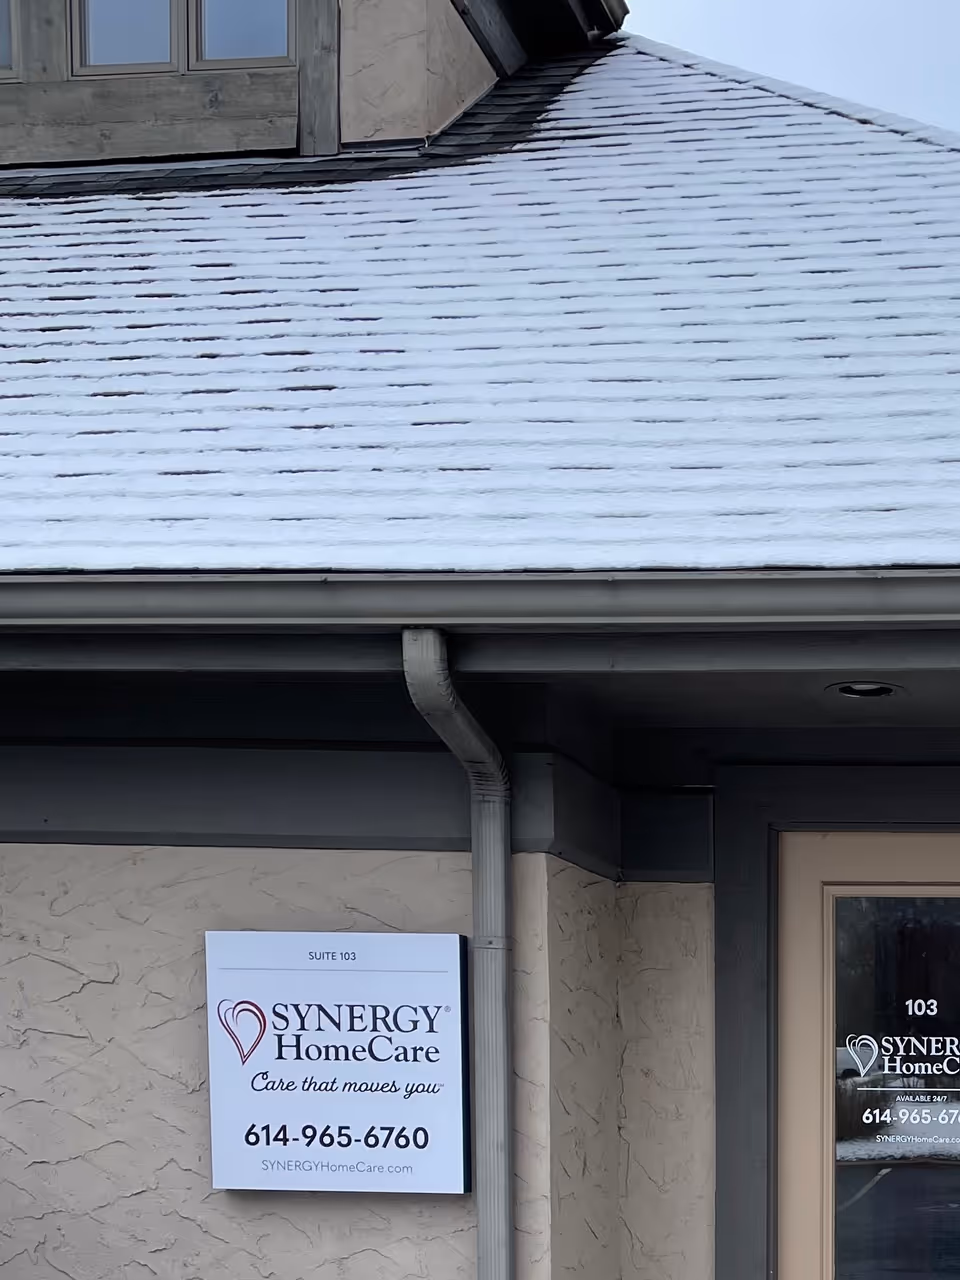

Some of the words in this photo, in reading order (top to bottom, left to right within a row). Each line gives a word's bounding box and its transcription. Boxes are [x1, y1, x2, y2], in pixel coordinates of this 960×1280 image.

[309, 952, 337, 960] SUITE
[340, 952, 356, 961] 103
[906, 999, 937, 1015] 103
[275, 1034, 440, 1062] HomeCare
[251, 1071, 297, 1092] Care
[302, 1077, 339, 1092] that
[343, 1081, 400, 1092] moves
[244, 1124, 429, 1149] 614-965-6760
[262, 1160, 413, 1174] SYNERGYHomeCare.com
